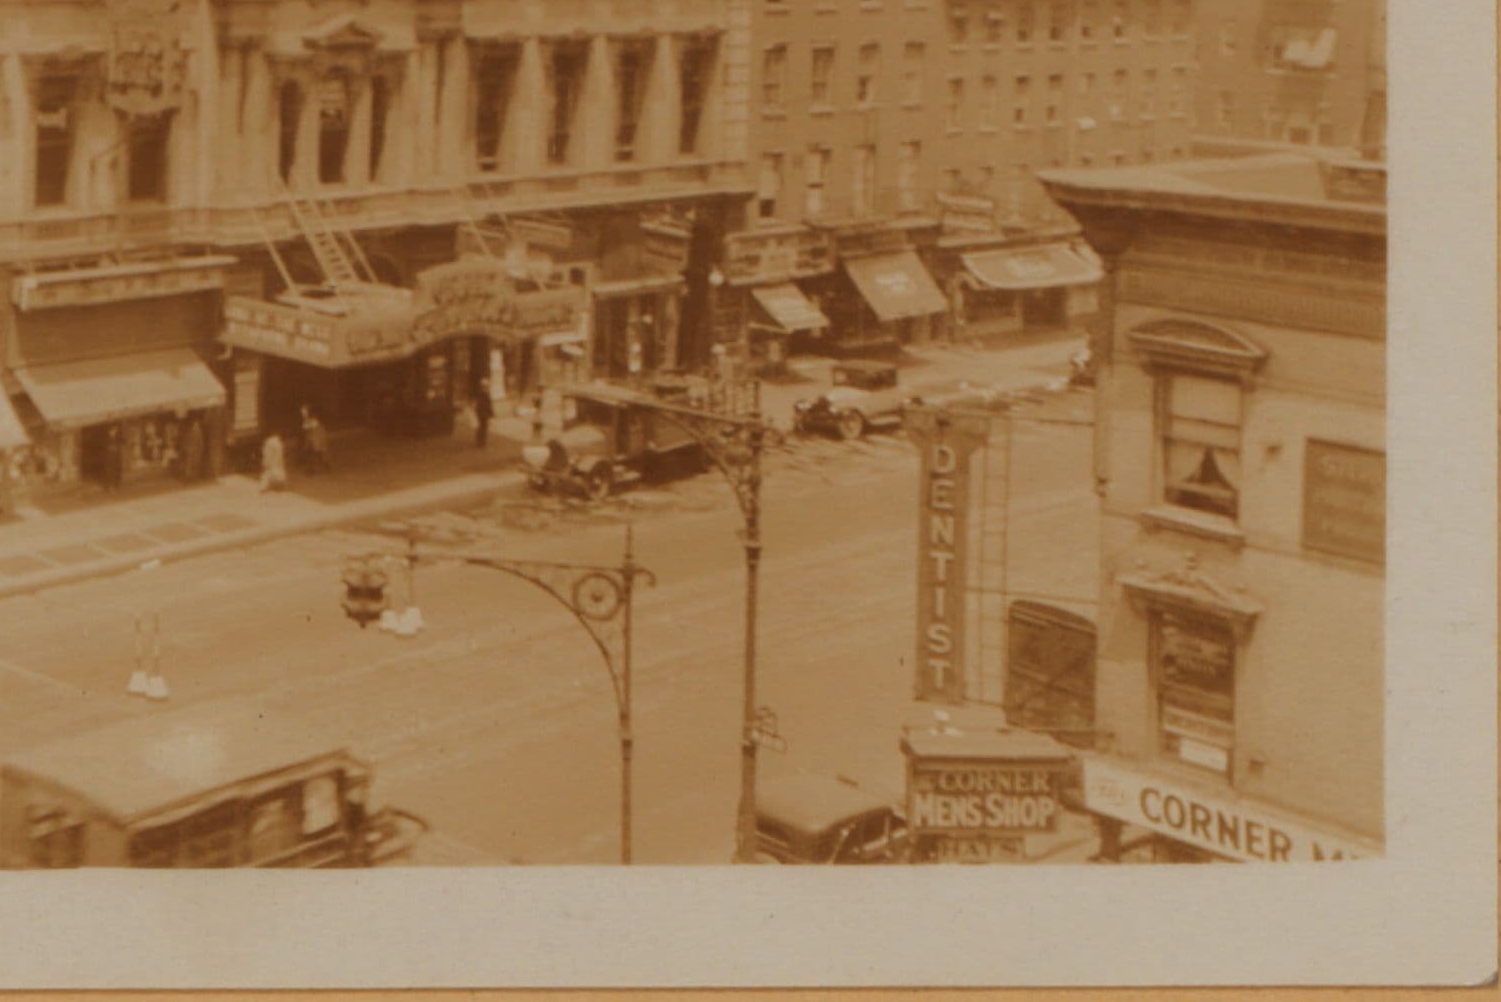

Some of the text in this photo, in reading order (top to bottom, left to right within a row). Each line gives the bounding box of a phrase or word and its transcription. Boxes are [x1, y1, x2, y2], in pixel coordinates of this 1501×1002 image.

[926, 444, 956, 689] DENTIST
[938, 770, 1050, 791] CORNER
[1139, 786, 1294, 862] CORNER
